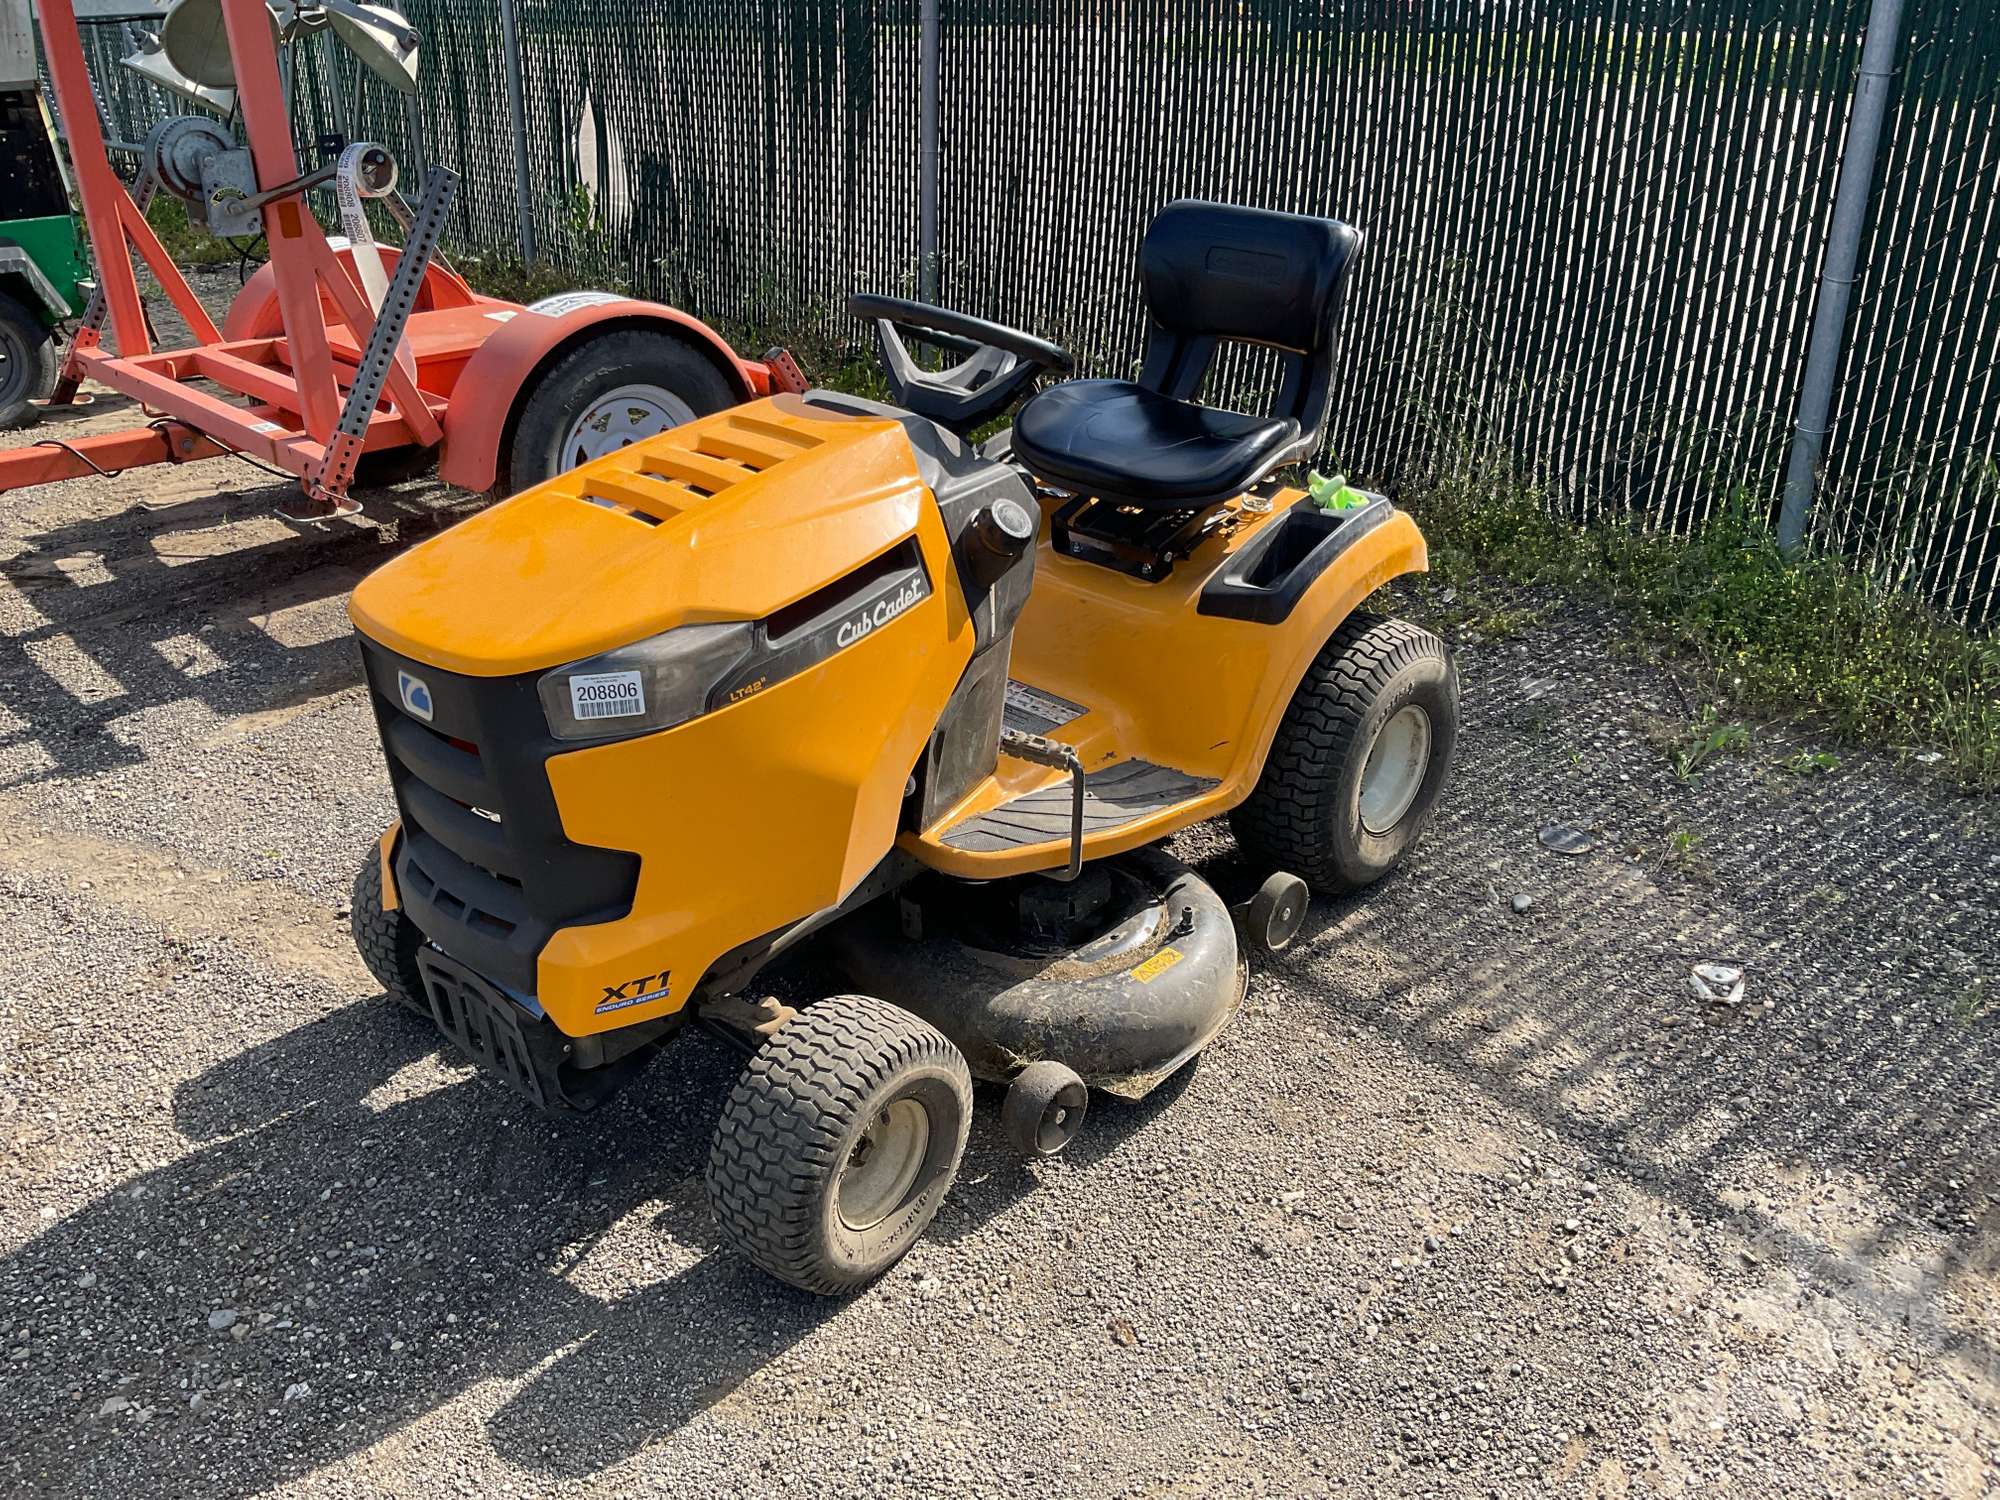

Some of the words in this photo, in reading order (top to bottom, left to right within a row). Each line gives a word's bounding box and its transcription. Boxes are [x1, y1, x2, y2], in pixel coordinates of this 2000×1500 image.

[343, 176, 356, 208] 208808
[350, 213, 367, 243] 208807
[837, 621, 872, 648] Cub
[873, 578, 922, 627] Cadet
[577, 682, 638, 701] 208806
[598, 970, 671, 1005] XT1
[596, 1000, 634, 1014] ENDURO
